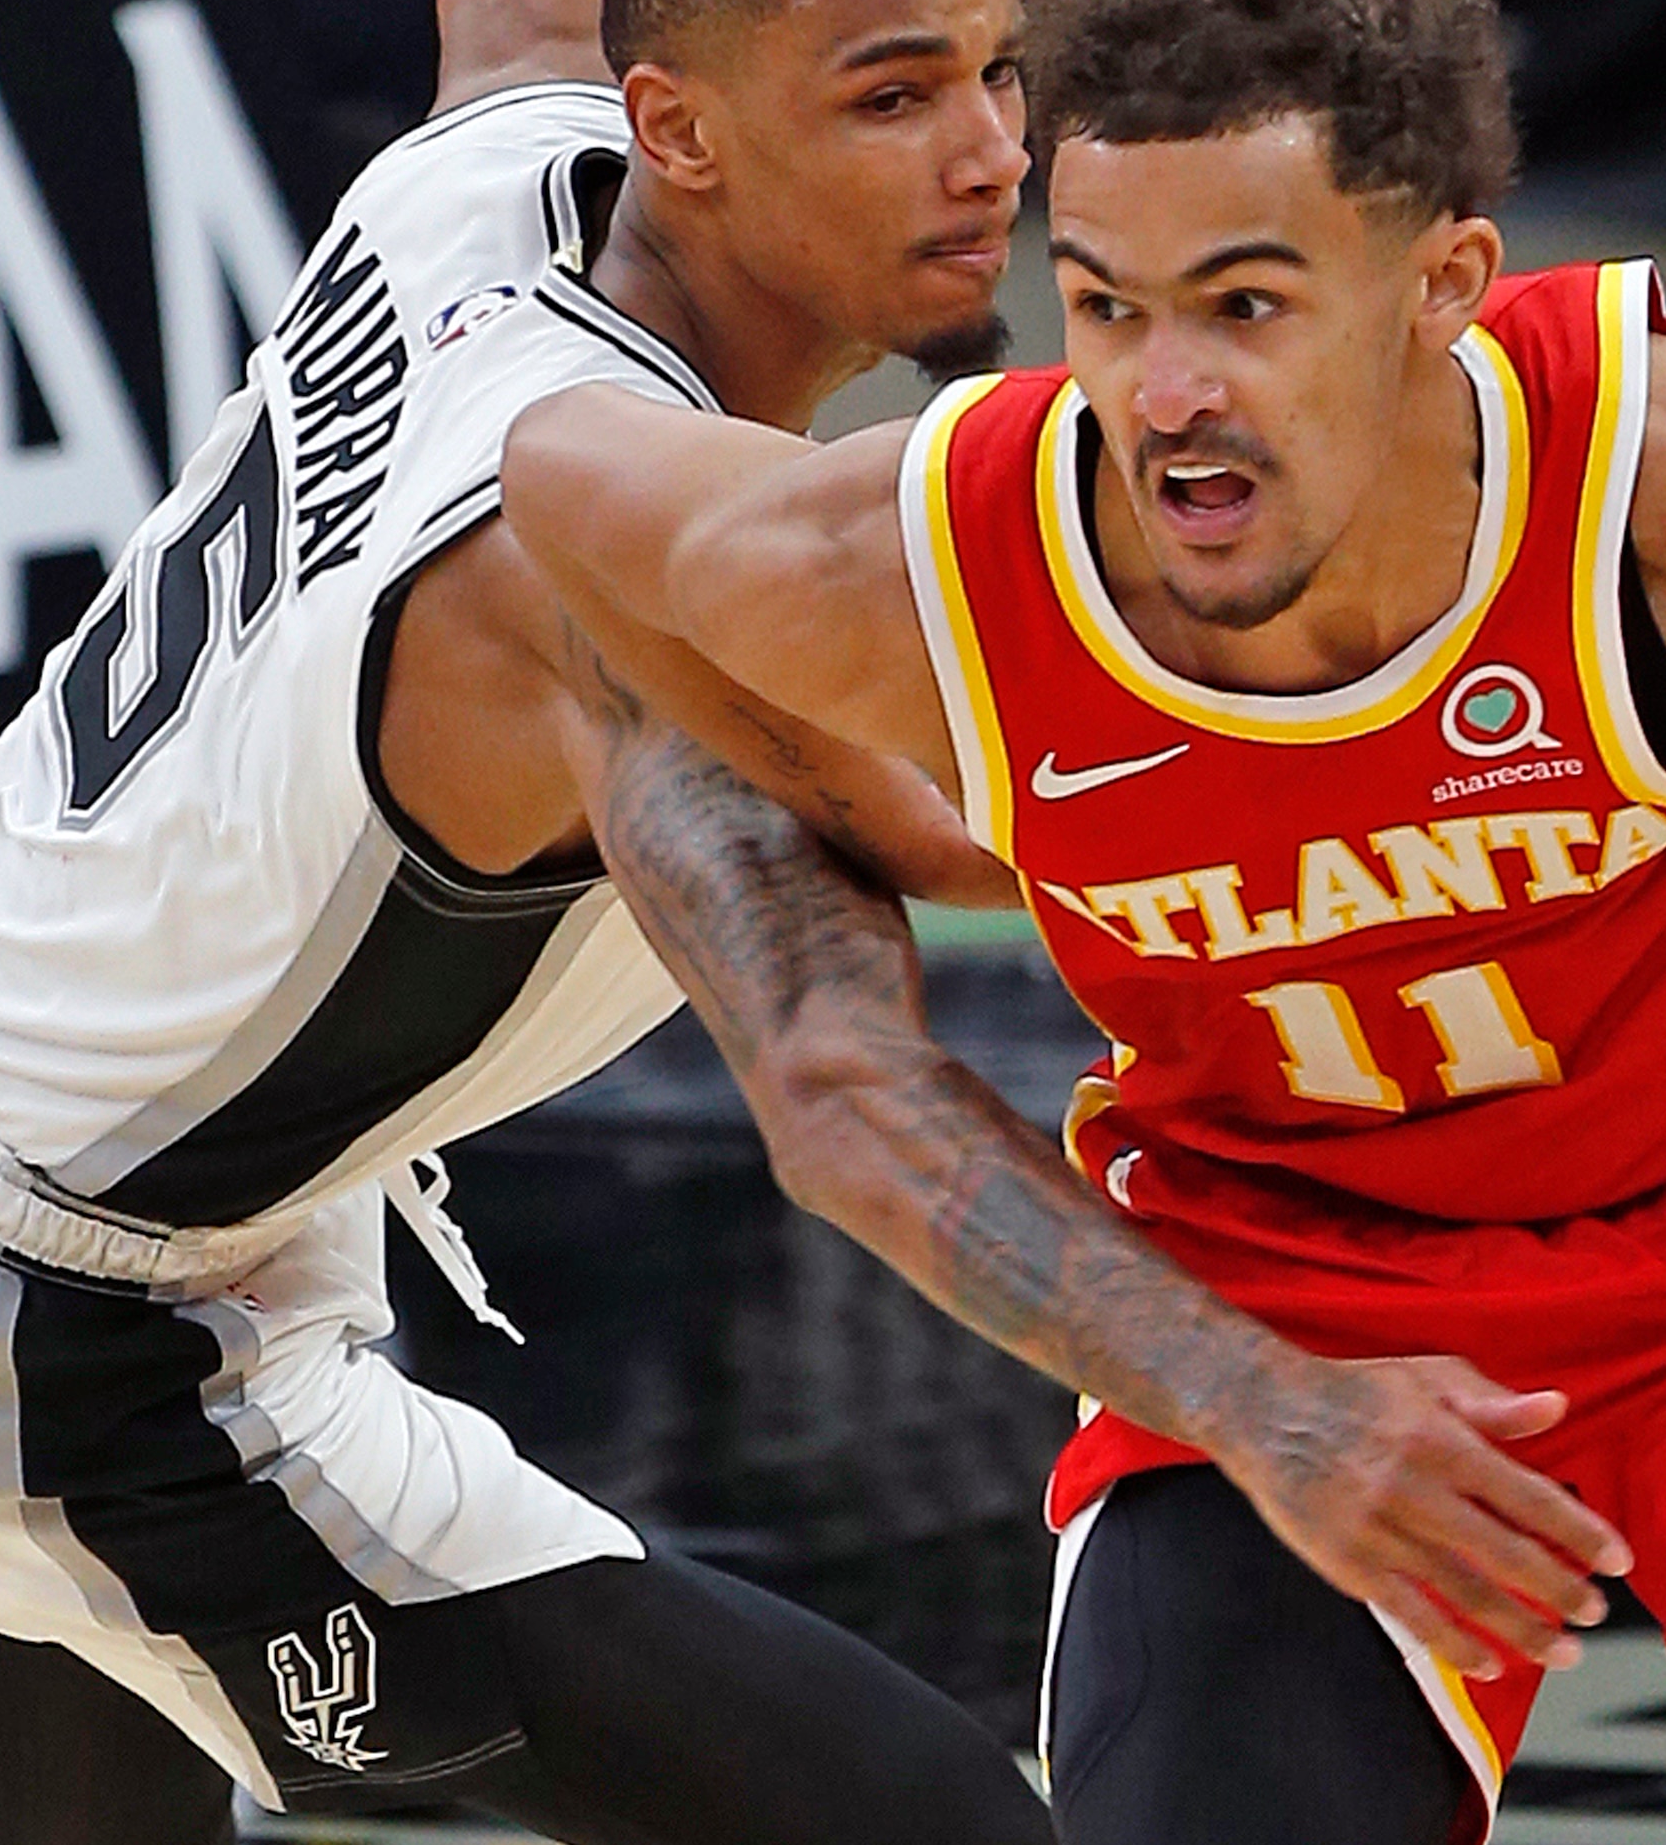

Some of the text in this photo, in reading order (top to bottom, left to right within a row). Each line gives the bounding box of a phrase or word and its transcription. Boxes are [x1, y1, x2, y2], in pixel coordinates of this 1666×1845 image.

[274, 222, 409, 595] MURRAY
[57, 395, 290, 833] 5
[1431, 758, 1584, 803] sharecare
[1241, 960, 1565, 1114] 11
